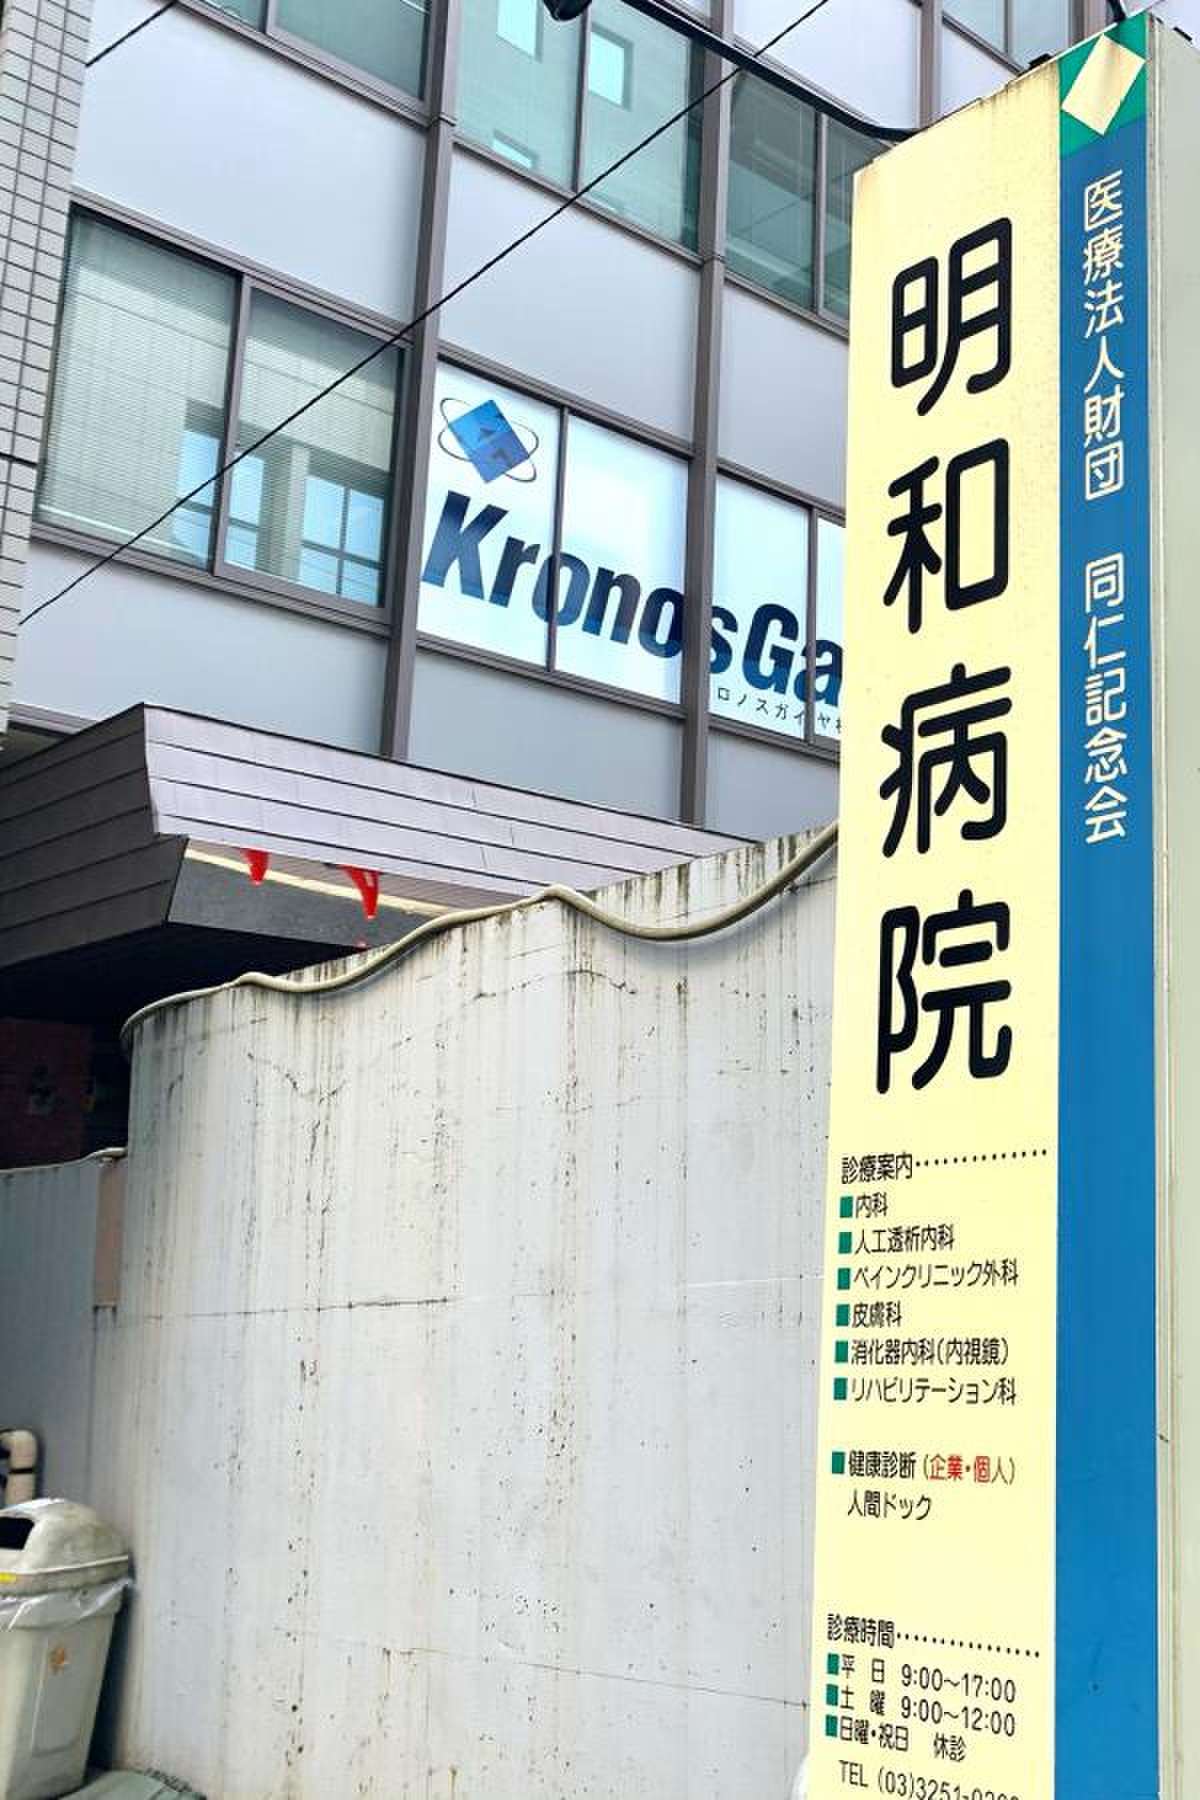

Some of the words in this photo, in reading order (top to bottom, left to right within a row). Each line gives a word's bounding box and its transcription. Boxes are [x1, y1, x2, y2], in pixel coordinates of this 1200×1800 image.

[1083, 169, 1125, 502] 医療法人財団
[876, 216, 1014, 1095] 明和病院
[1083, 551, 1128, 845] 同仁記念会
[841, 1152, 914, 1185] 診療案内
[854, 1192, 888, 1218] 内科
[854, 1224, 955, 1256] 人工透析内科
[852, 1258, 1019, 1289] ペインクリニック外科
[851, 1301, 902, 1328] 皮膚科
[851, 1377, 1017, 1406] リハビリテーション科
[847, 1489, 932, 1521] 人間ドック
[827, 1613, 896, 1650] 診療時間
[839, 1716, 909, 1752] 日曜・祝日
[933, 1732, 967, 1763] 休診
[838, 1760, 869, 1788] TEL
